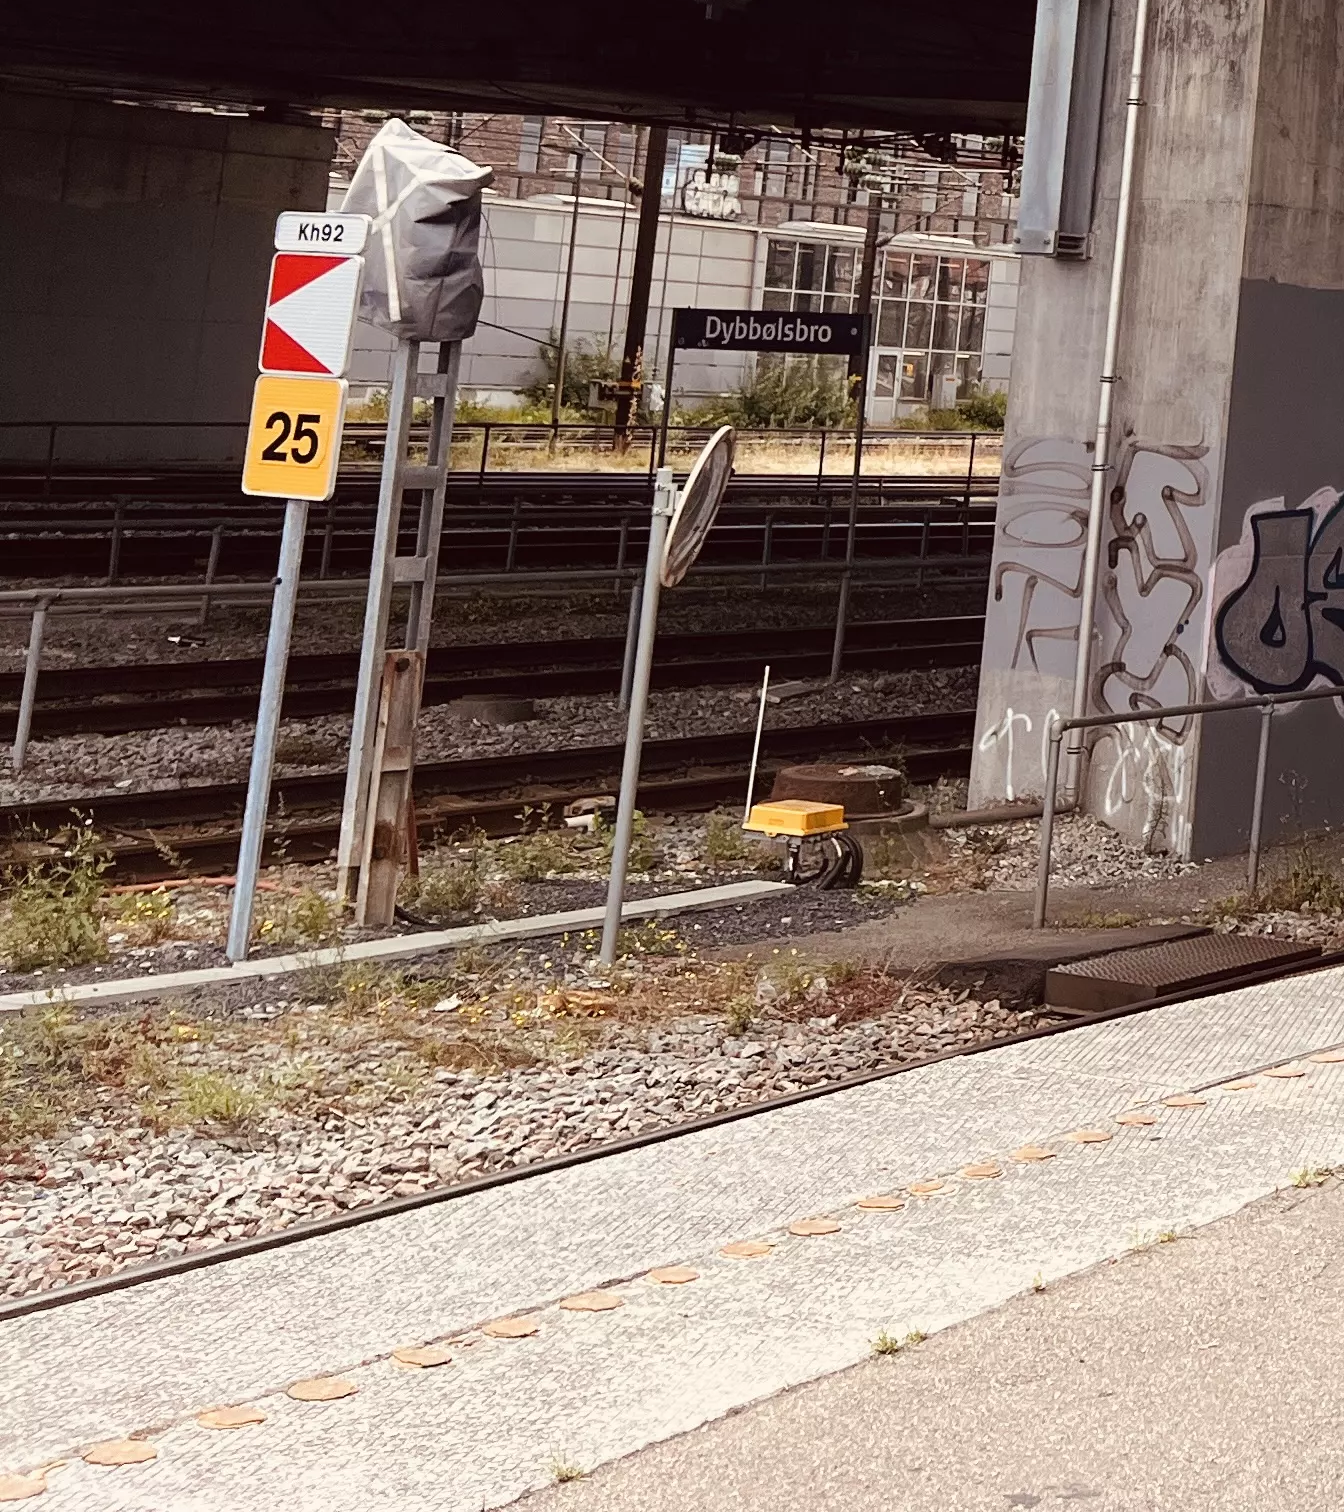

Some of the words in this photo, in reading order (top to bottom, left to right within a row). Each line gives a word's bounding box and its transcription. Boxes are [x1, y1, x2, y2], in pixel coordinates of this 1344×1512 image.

[298, 223, 344, 242] Kh92
[705, 315, 832, 344] Dybbølsbro
[261, 411, 321, 464] 25
